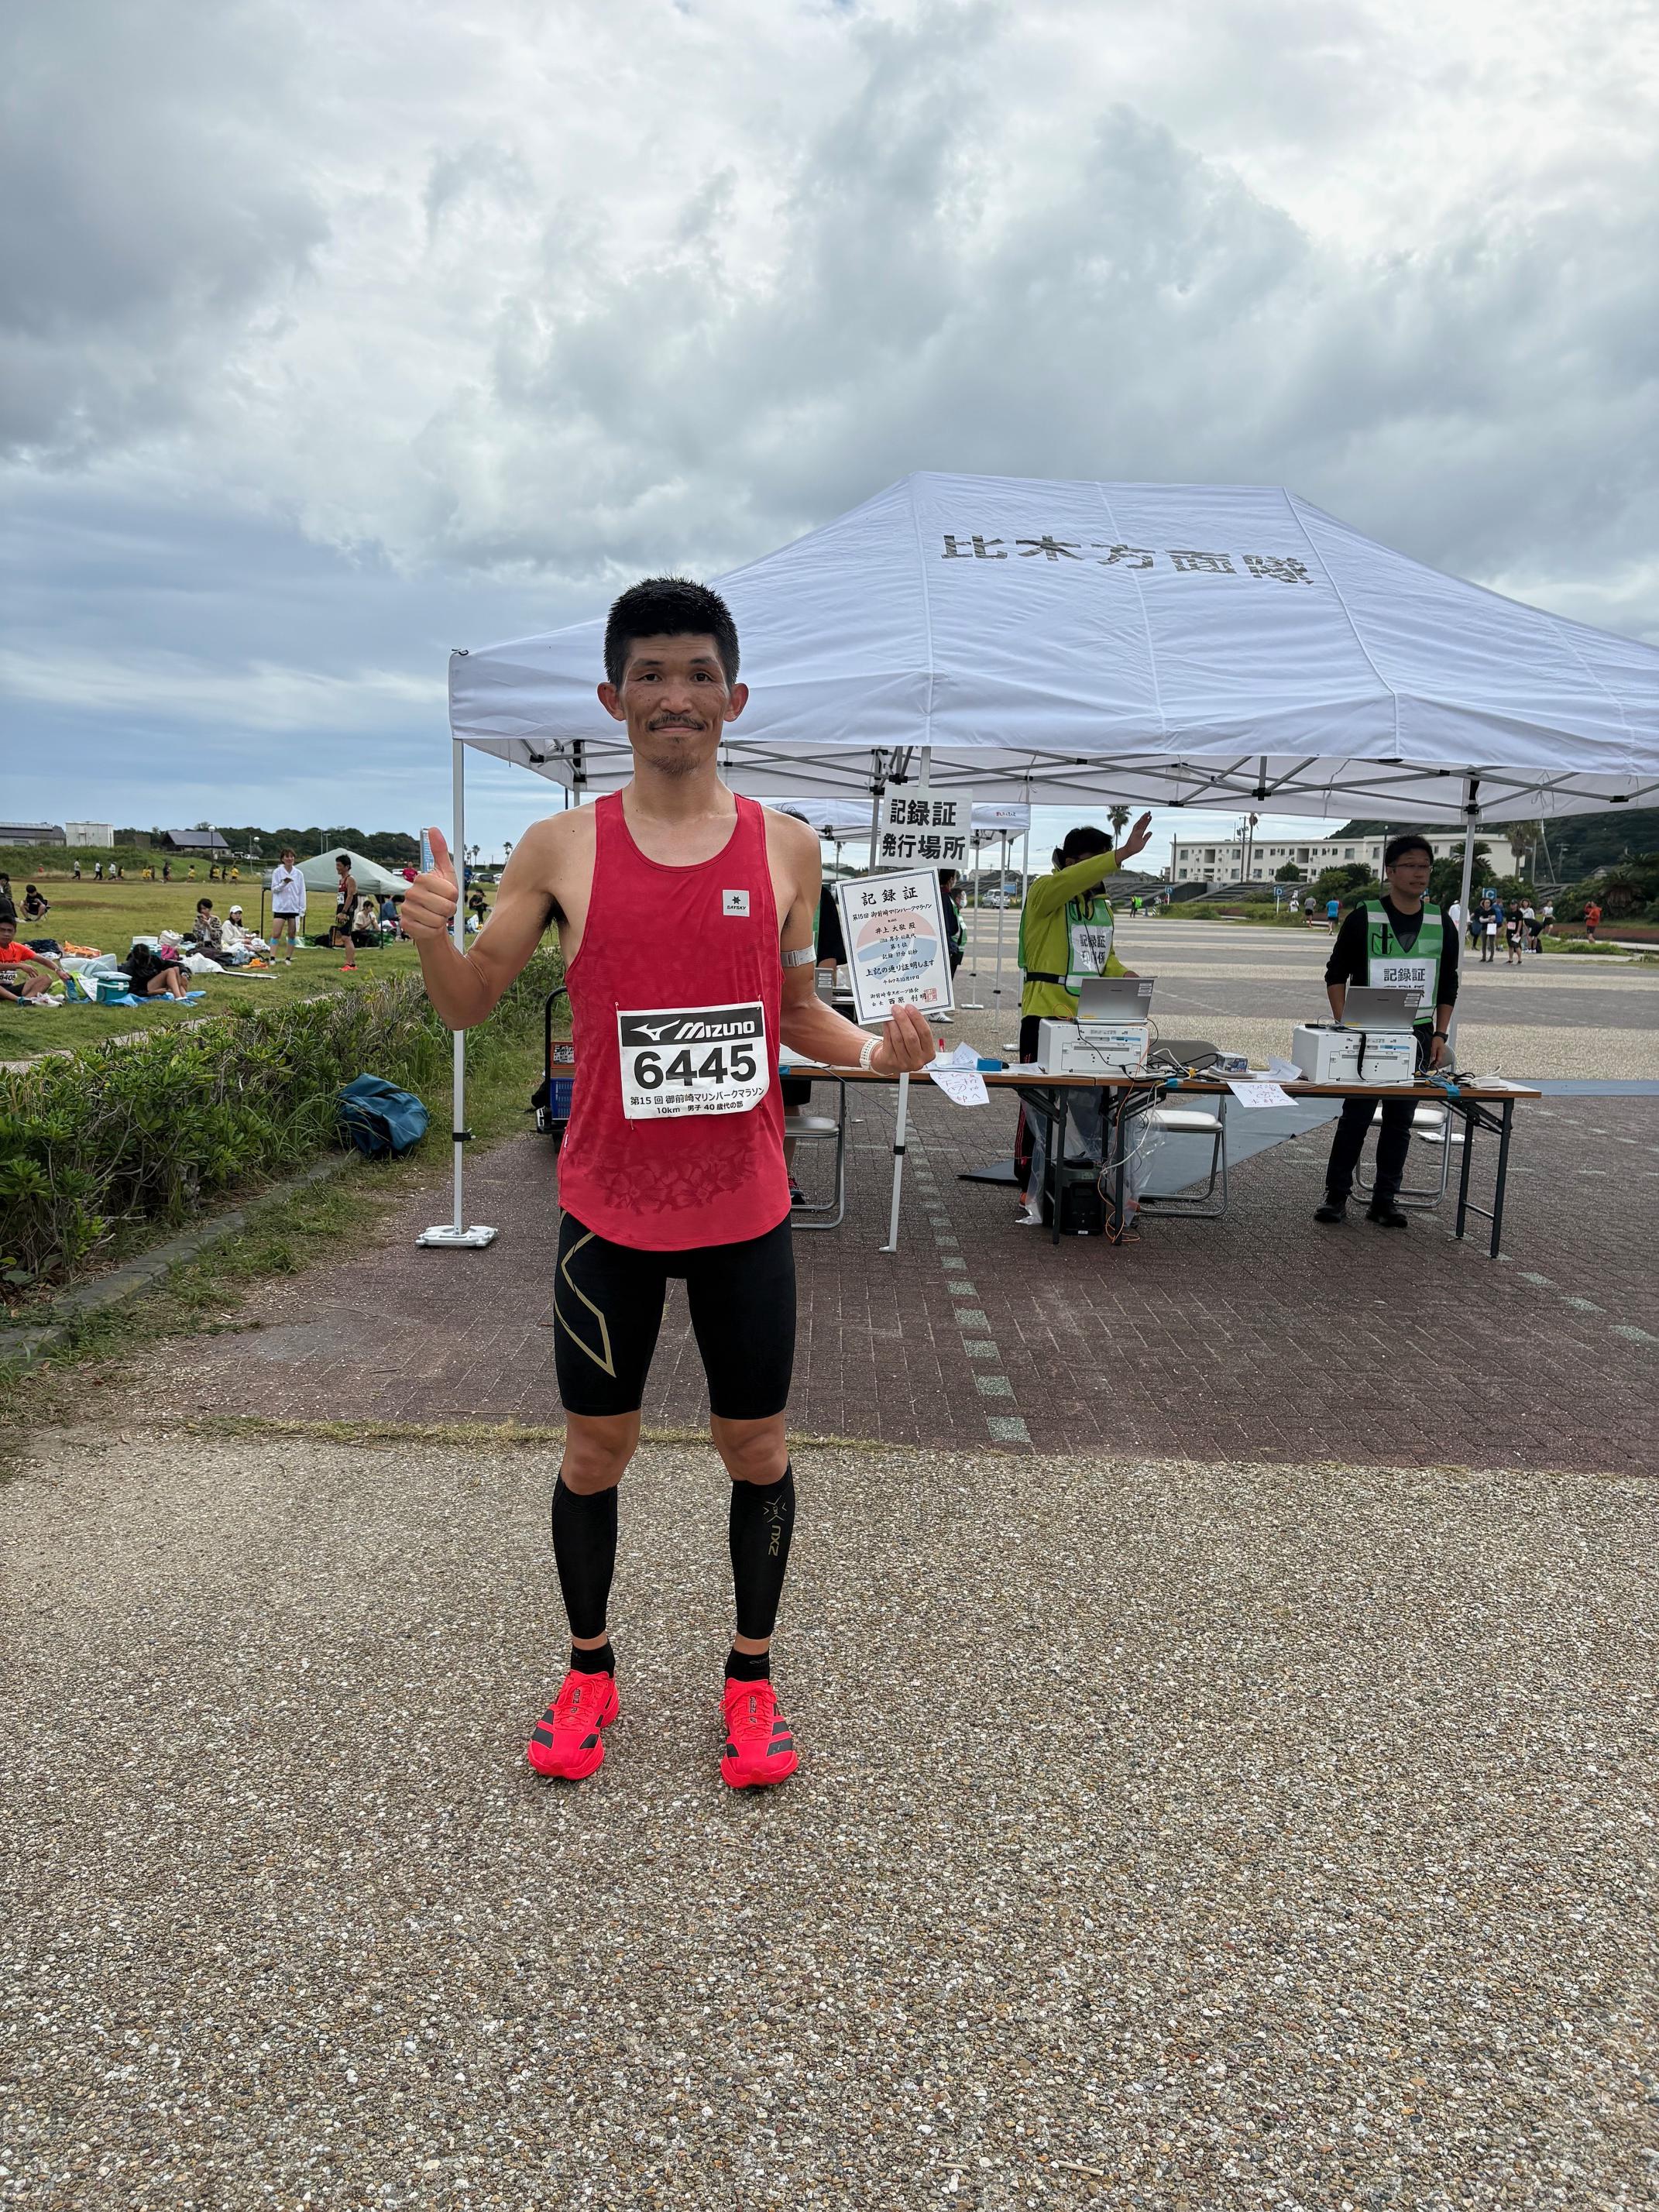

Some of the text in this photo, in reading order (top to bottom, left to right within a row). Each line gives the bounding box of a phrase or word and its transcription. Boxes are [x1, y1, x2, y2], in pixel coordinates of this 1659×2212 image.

[940, 534, 1315, 585] 比木方面隊
[889, 799, 957, 826] 記録証
[882, 833, 966, 860] 発行場所
[861, 886, 919, 906] 記録証
[865, 959, 935, 977] 上記の通り証明します
[1383, 967, 1426, 982] 記録証
[634, 1043, 757, 1090] 6445
[657, 1106, 681, 1115] 10km
[768, 1524, 781, 1557] 2XU
